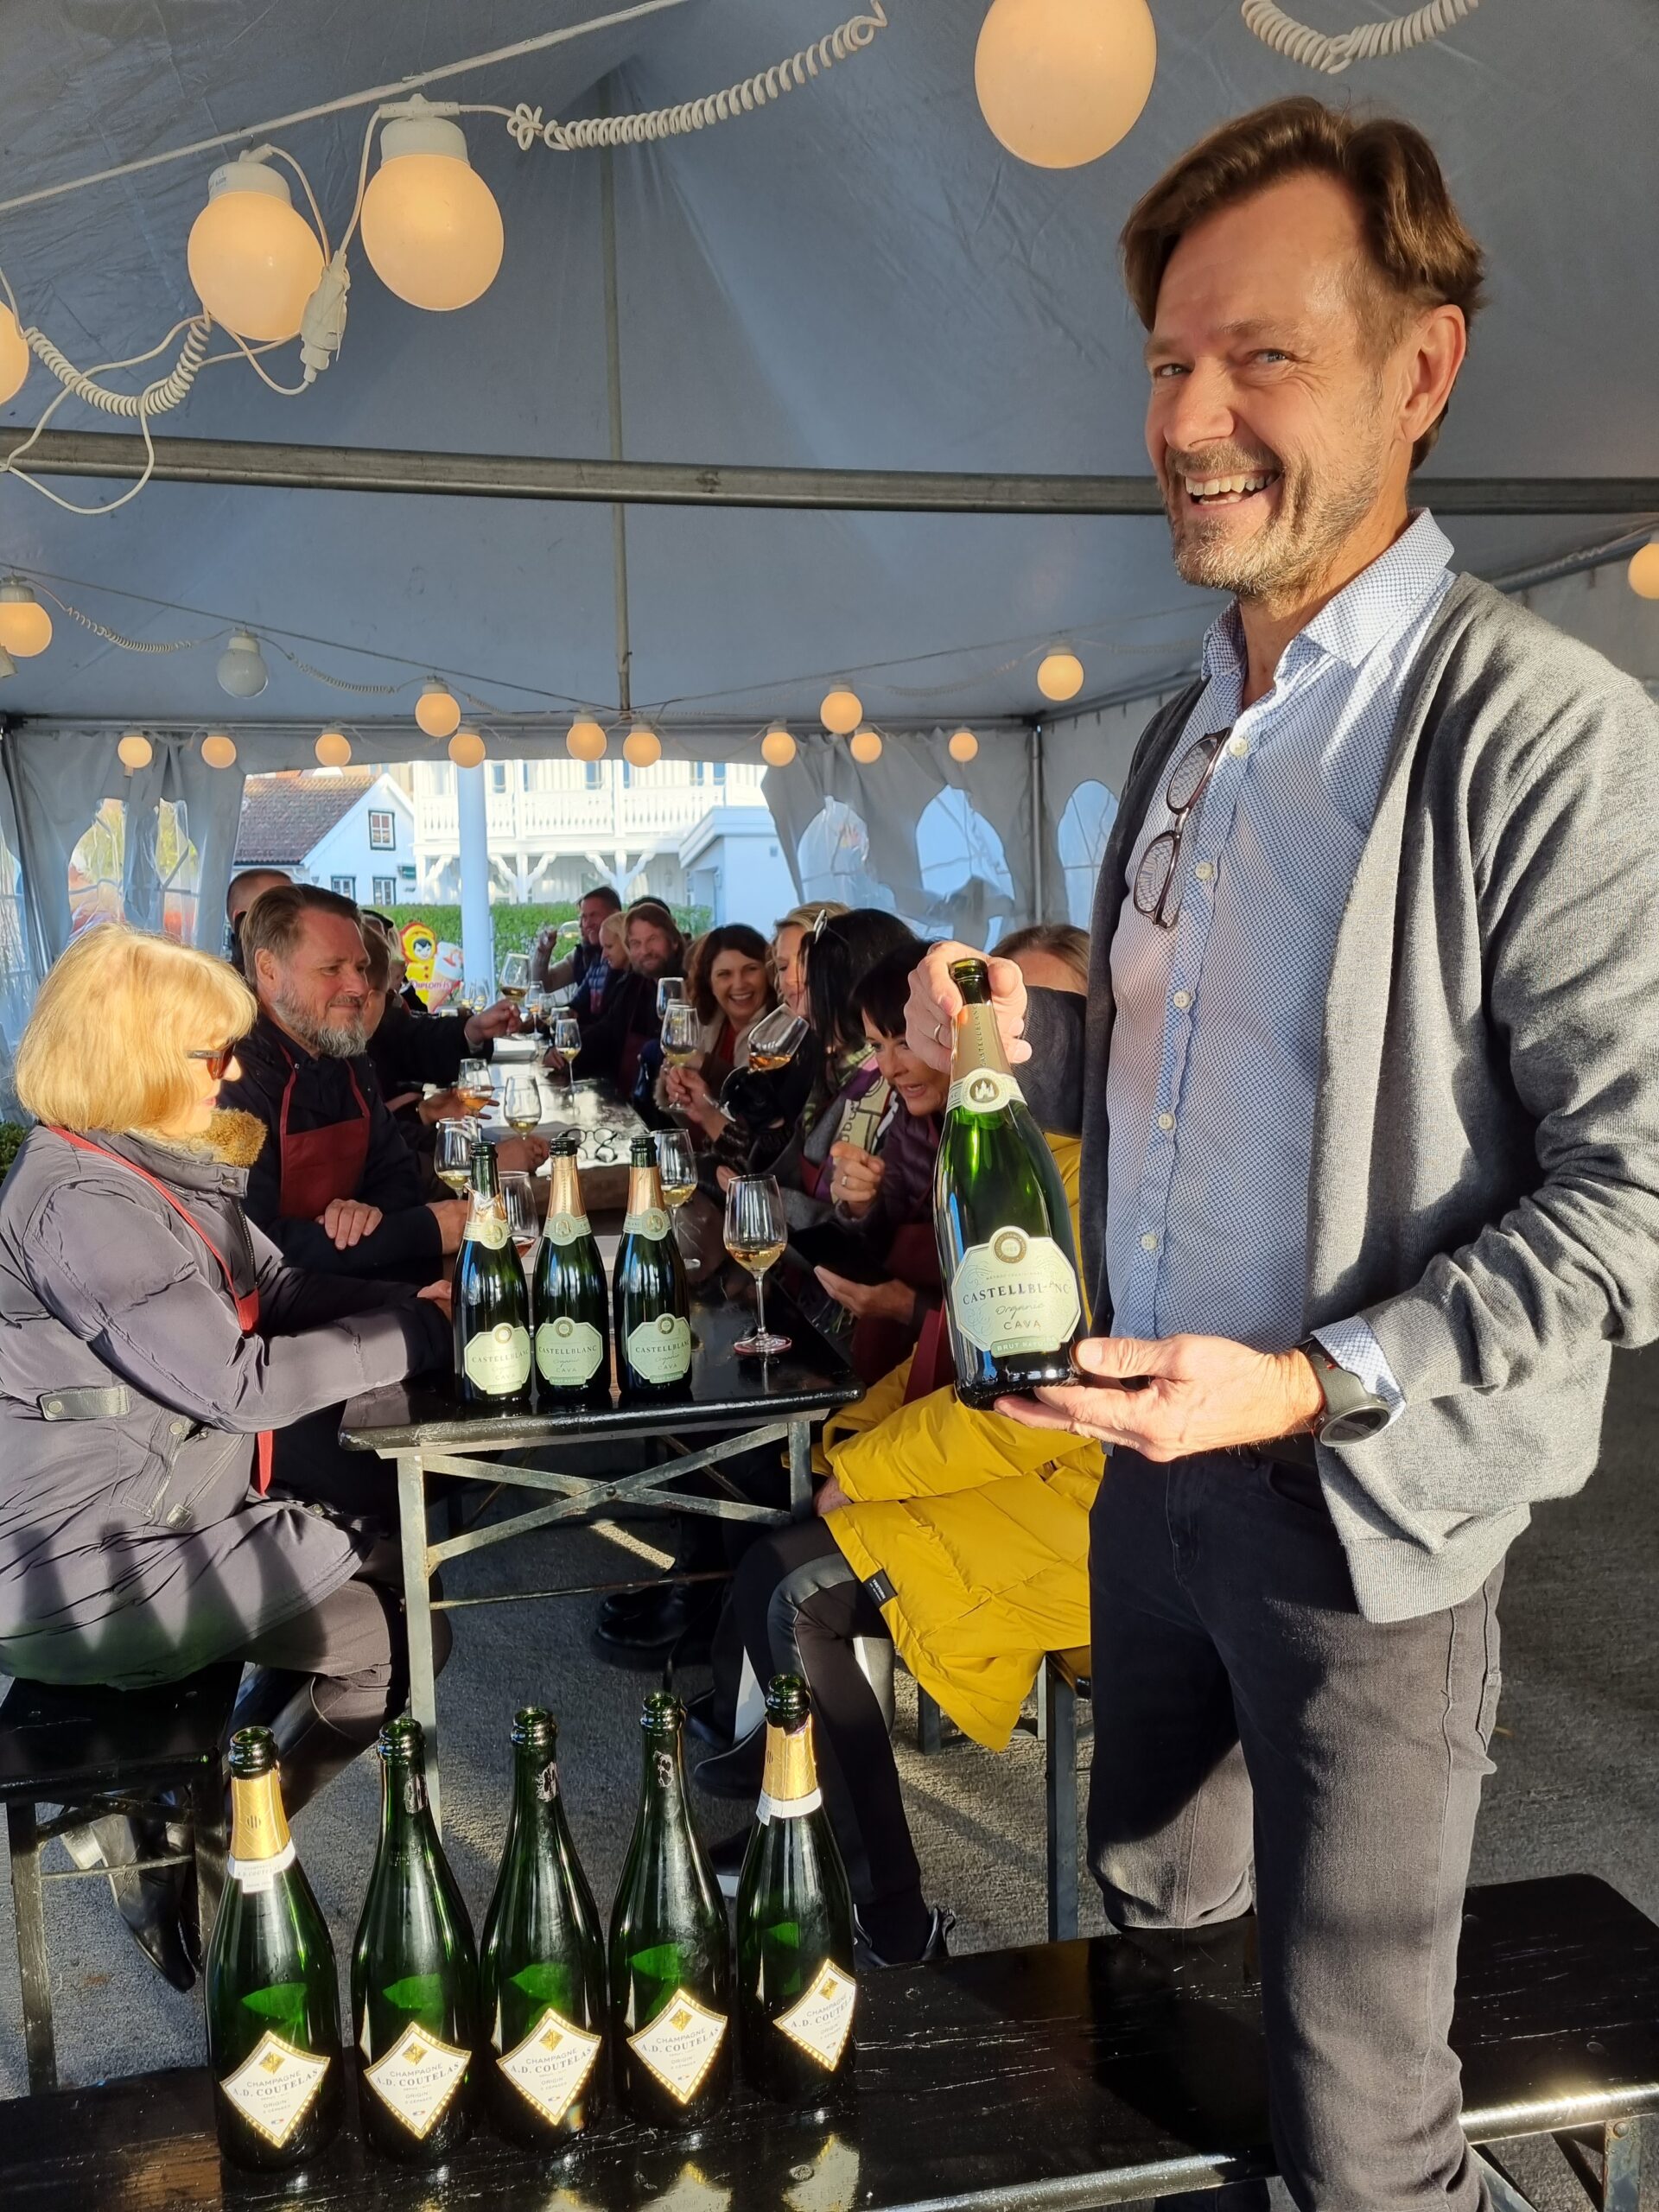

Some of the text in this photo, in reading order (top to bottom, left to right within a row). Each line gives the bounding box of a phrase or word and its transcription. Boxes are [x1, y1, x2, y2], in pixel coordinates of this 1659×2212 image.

[963, 1281, 1071, 1306] CASTELLBLANC
[995, 1302, 1045, 1320] Organic
[1003, 1319, 1042, 1331] CAVA
[472, 1347, 529, 1363] CASTELLBLANC
[538, 1344, 597, 1355] CASTELLBLANC
[996, 1342, 1019, 1351] BRUT
[791, 2019, 812, 2028] A.D.
[656, 2027, 705, 2044] CHAMPAGNE
[665, 2026, 719, 2053] COUTELAS
[525, 2047, 578, 2064] CHAMPAGNE
[535, 2045, 592, 2074] COUTELAS
[246, 2069, 301, 2088] CHAMPAGNE
[390, 2063, 442, 2077] CHAMPAGNE
[398, 2062, 459, 2087] COUTELAS
[256, 2069, 318, 2096] COUTELAS
